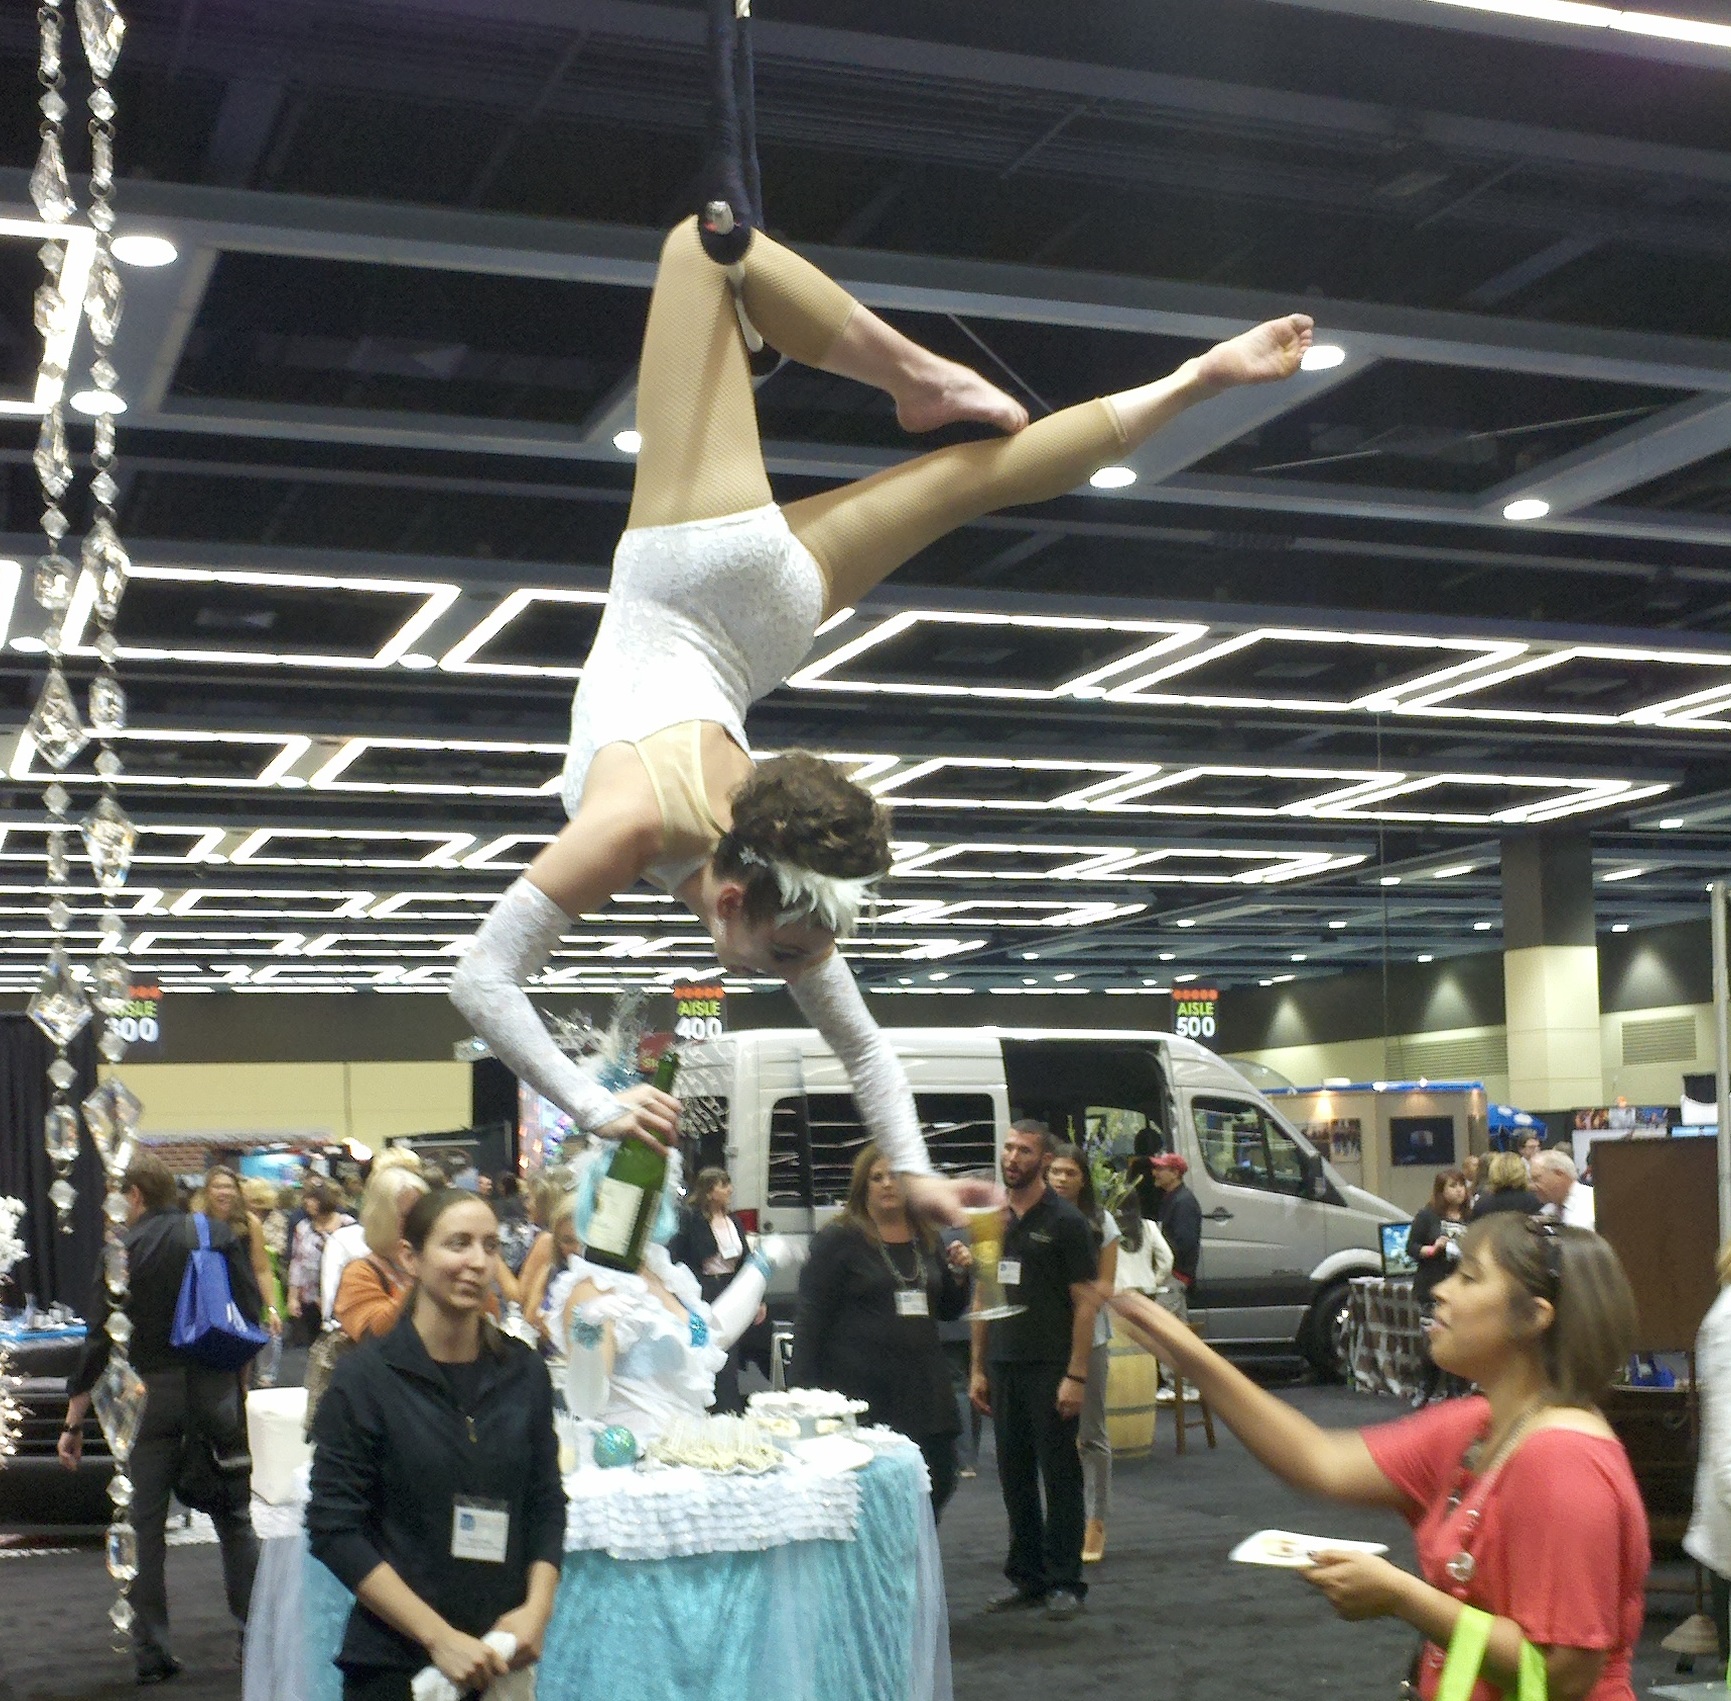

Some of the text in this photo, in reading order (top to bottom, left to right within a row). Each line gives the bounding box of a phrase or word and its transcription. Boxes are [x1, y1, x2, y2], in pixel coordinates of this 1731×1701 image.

[677, 1000, 721, 1016] AISLE
[1176, 1001, 1214, 1016] AISLE
[674, 1016, 722, 1040] 400
[1175, 1016, 1215, 1037] 500
